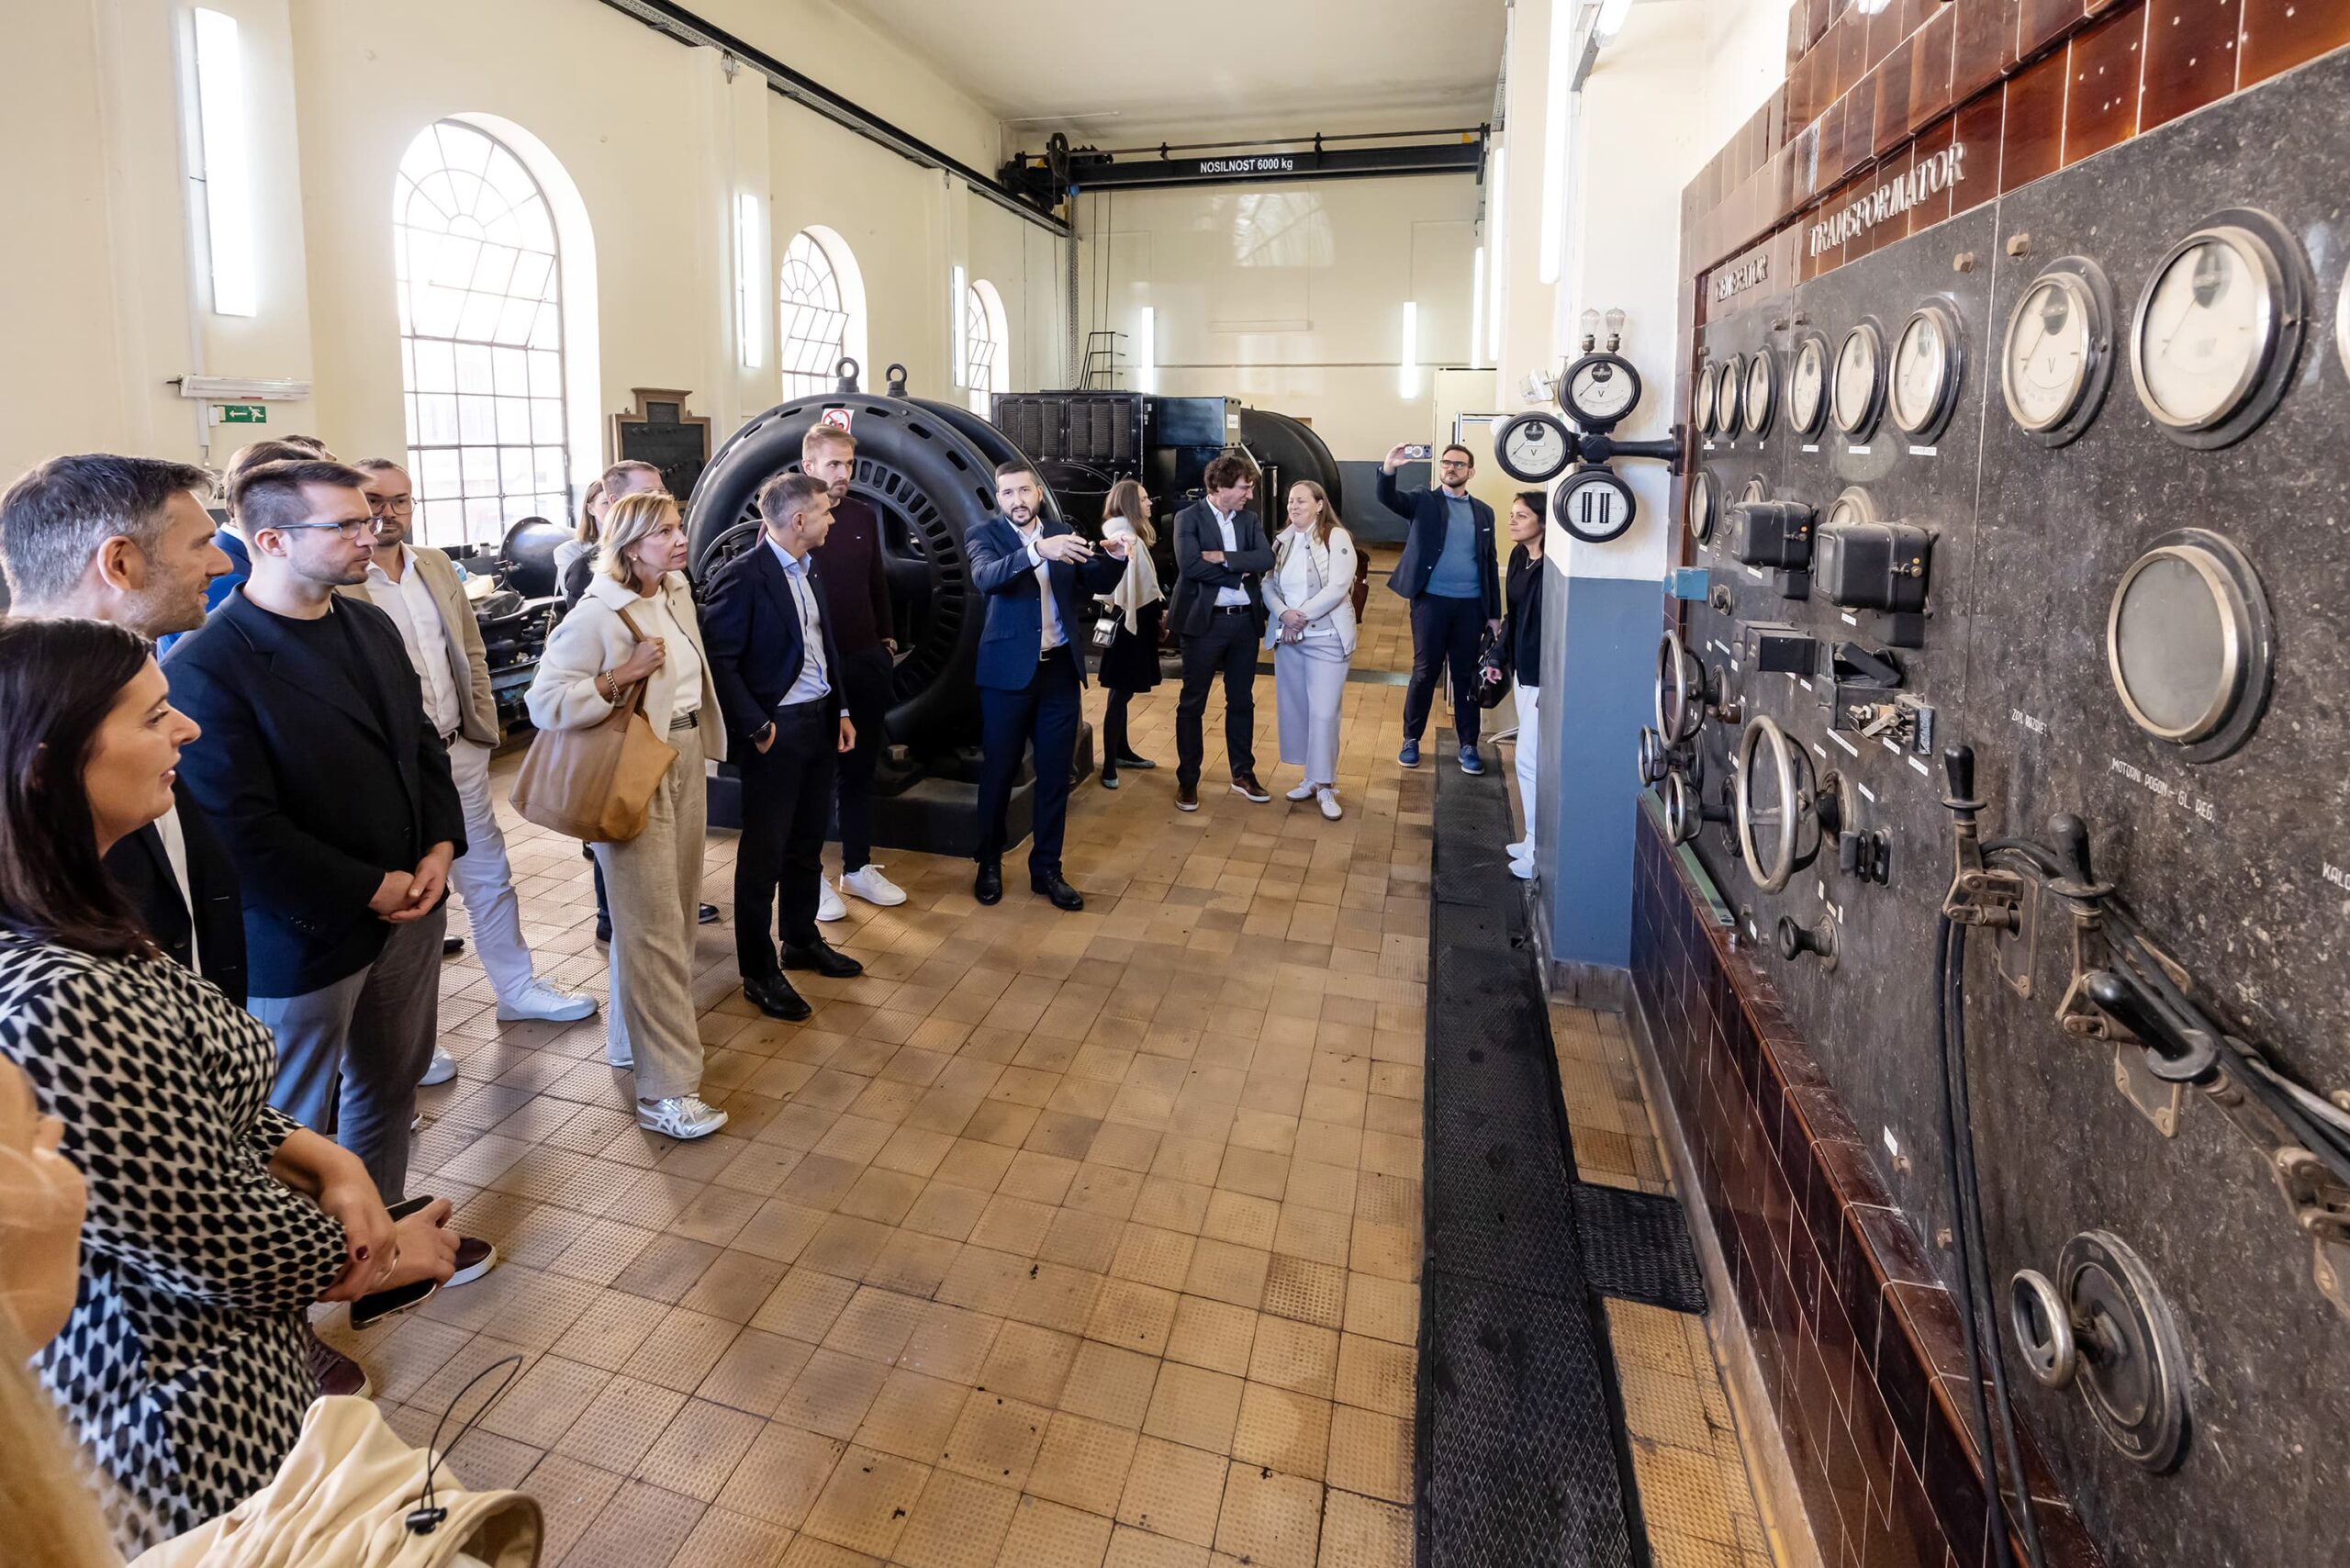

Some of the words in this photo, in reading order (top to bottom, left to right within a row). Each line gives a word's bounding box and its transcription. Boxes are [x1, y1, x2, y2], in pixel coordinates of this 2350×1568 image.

[1200, 159, 1255, 174] NOSILNOST
[1257, 158, 1280, 170] 6000
[1281, 158, 1293, 171] kg
[1809, 141, 1966, 257] TRANSFORMATOR
[2111, 756, 2142, 783] MOTORNI
[2144, 774, 2167, 797] POGON
[2195, 799, 2215, 823] REG.
